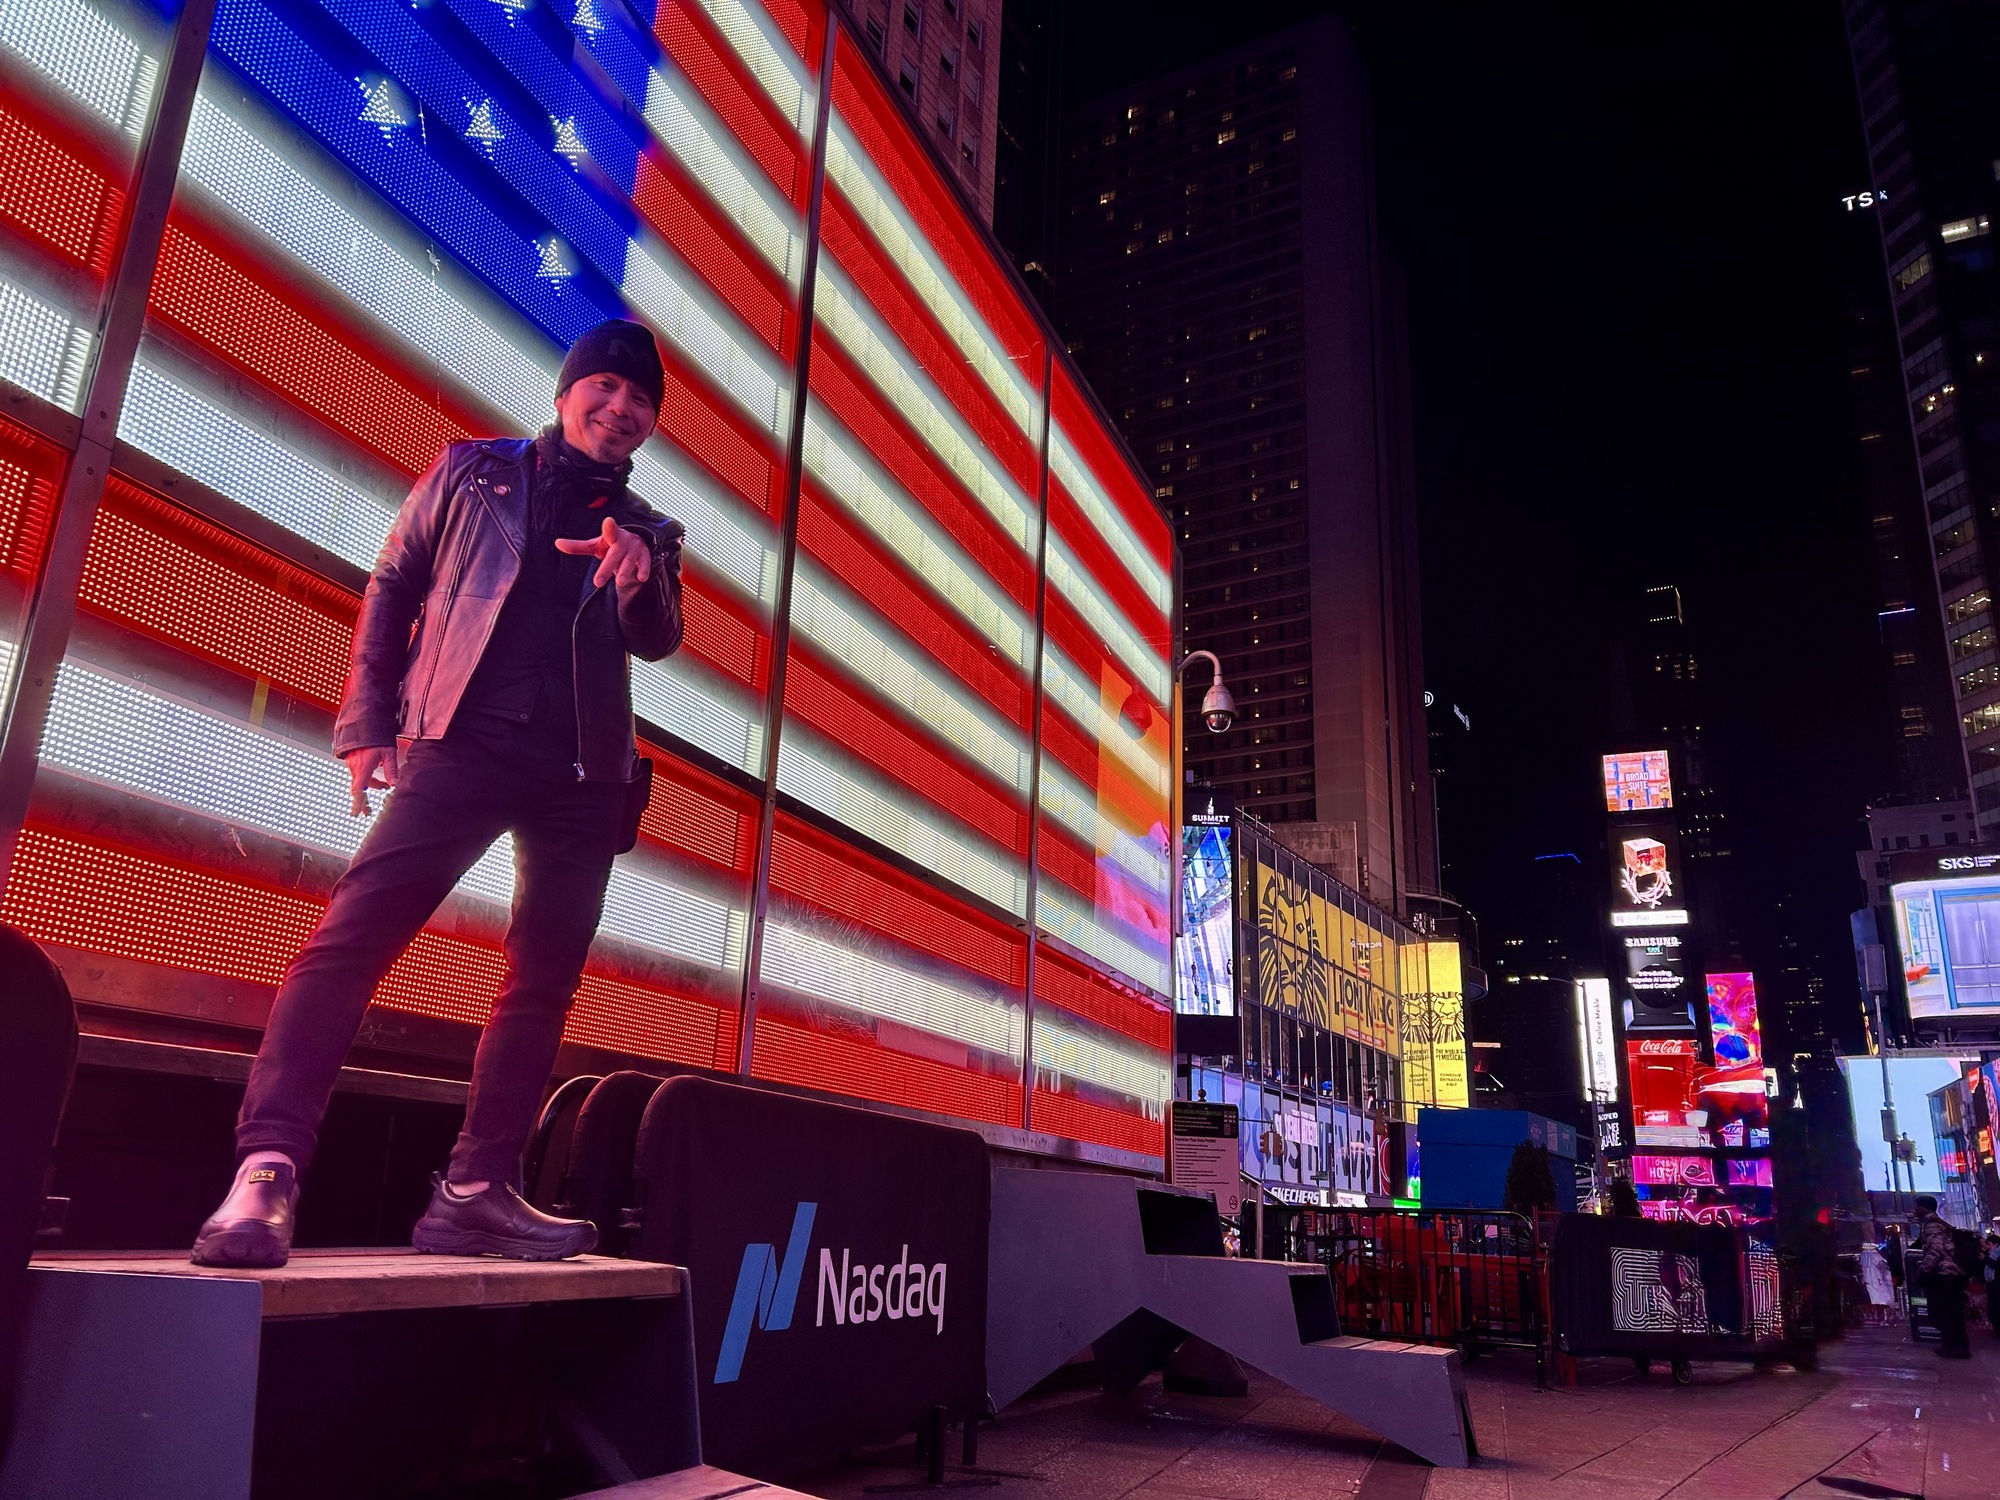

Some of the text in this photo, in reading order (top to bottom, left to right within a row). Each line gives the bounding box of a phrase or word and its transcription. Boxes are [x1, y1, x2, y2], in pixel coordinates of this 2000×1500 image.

[1625, 772, 1649, 781] BROAD
[1628, 781, 1648, 790] SUITE
[1192, 814, 1230, 823] SUMMIT
[1939, 856, 1974, 870] SKS
[1625, 936, 1679, 947] SAMSUNG
[1594, 998, 1602, 1020] Meikle
[1271, 1186, 1320, 1205] SKECHERS
[816, 1244, 947, 1336] Nasdaq
